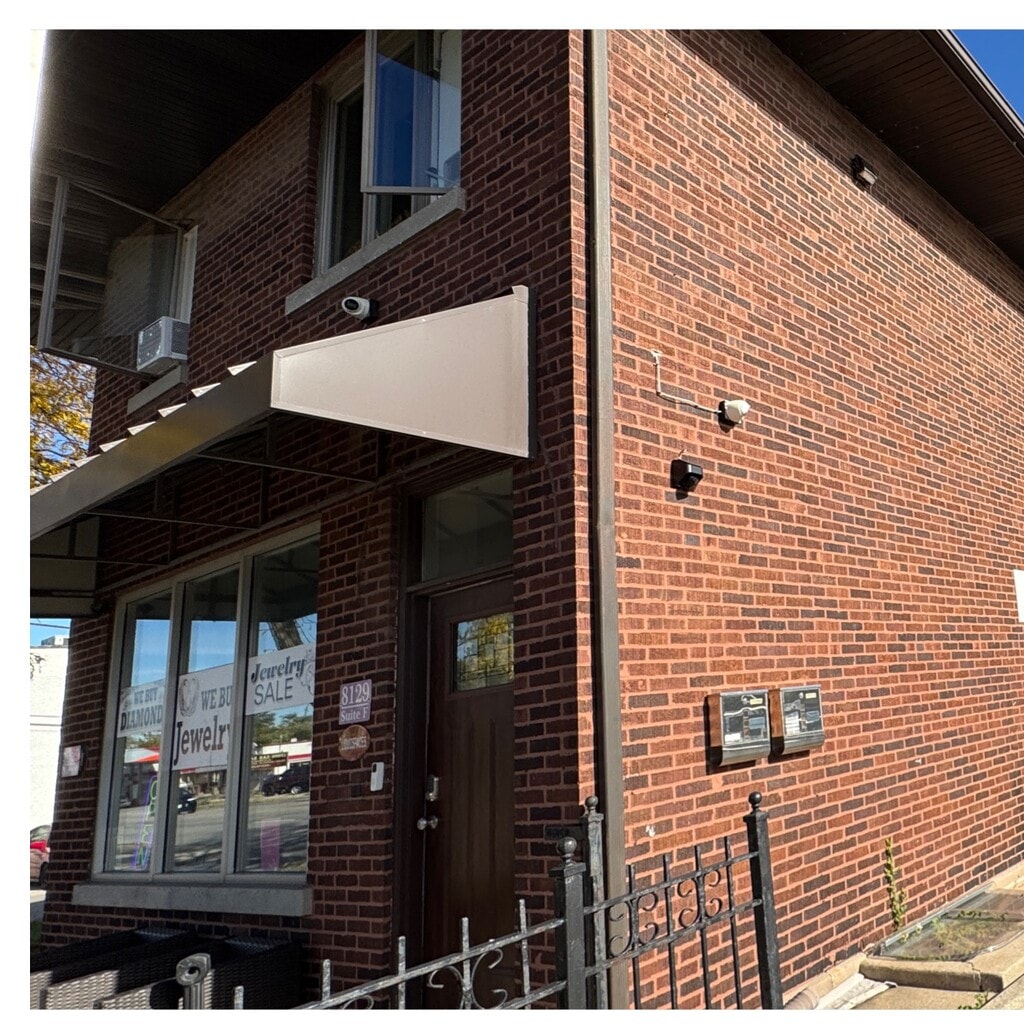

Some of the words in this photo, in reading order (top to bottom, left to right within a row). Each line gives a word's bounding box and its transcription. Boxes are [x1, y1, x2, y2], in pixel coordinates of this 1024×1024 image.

[251, 656, 305, 683] Jewelry
[201, 689, 217, 711] WE
[254, 677, 293, 706] SALE
[342, 682, 370, 706] 8129
[341, 709, 361, 721] Suite
[362, 707, 369, 719] F
